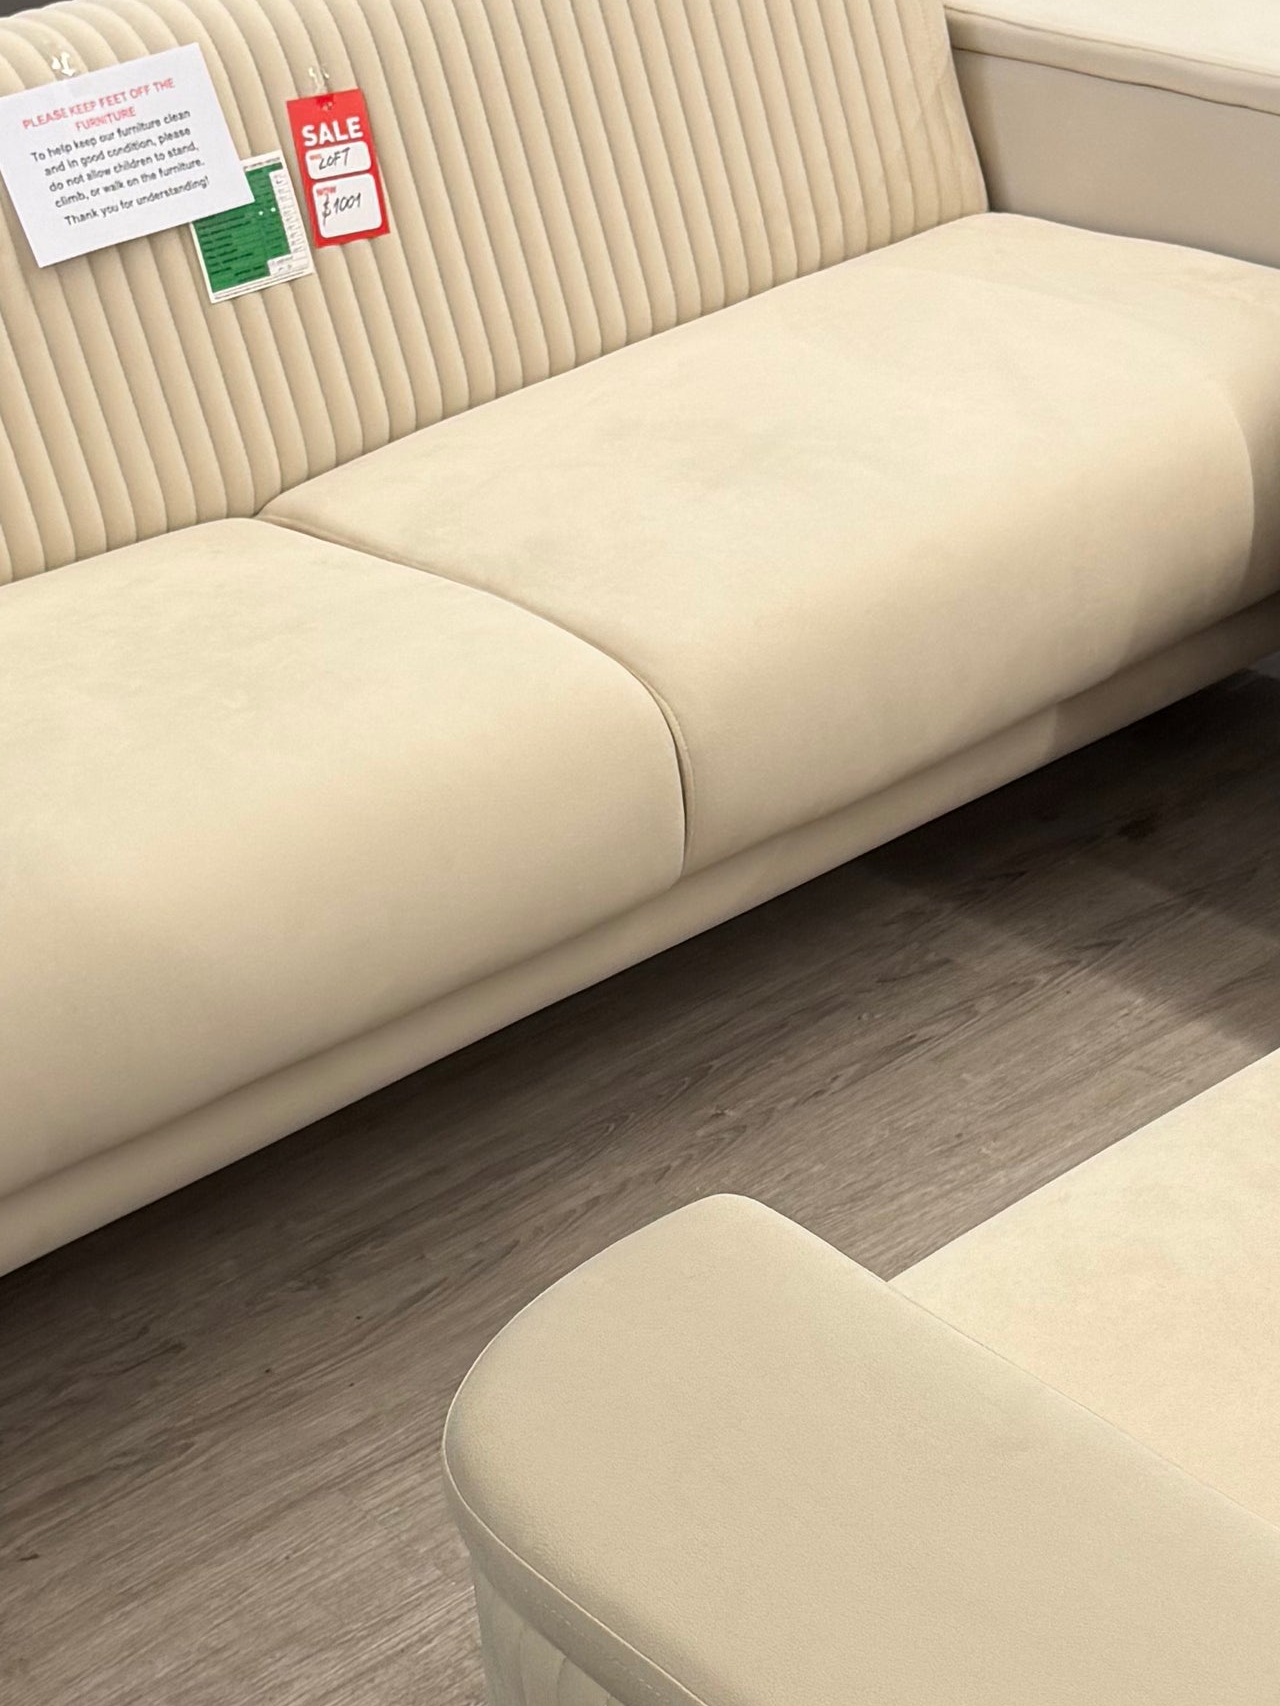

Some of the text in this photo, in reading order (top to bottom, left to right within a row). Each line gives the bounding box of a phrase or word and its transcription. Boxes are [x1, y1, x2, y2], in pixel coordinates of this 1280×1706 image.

[22, 77, 175, 130] PLEASE KEEP FEET OFF THE
[75, 106, 136, 131] FURNITURE
[30, 110, 191, 162] To help keep our furniture clean
[44, 127, 191, 177] and in good condition, please
[302, 116, 364, 147] SALE
[49, 140, 200, 192] do not allow children to stand,
[319, 146, 351, 170] LOFT
[55, 159, 206, 208] climb, or walk on the furniture.
[64, 175, 210, 226] Thank you for understanding!
